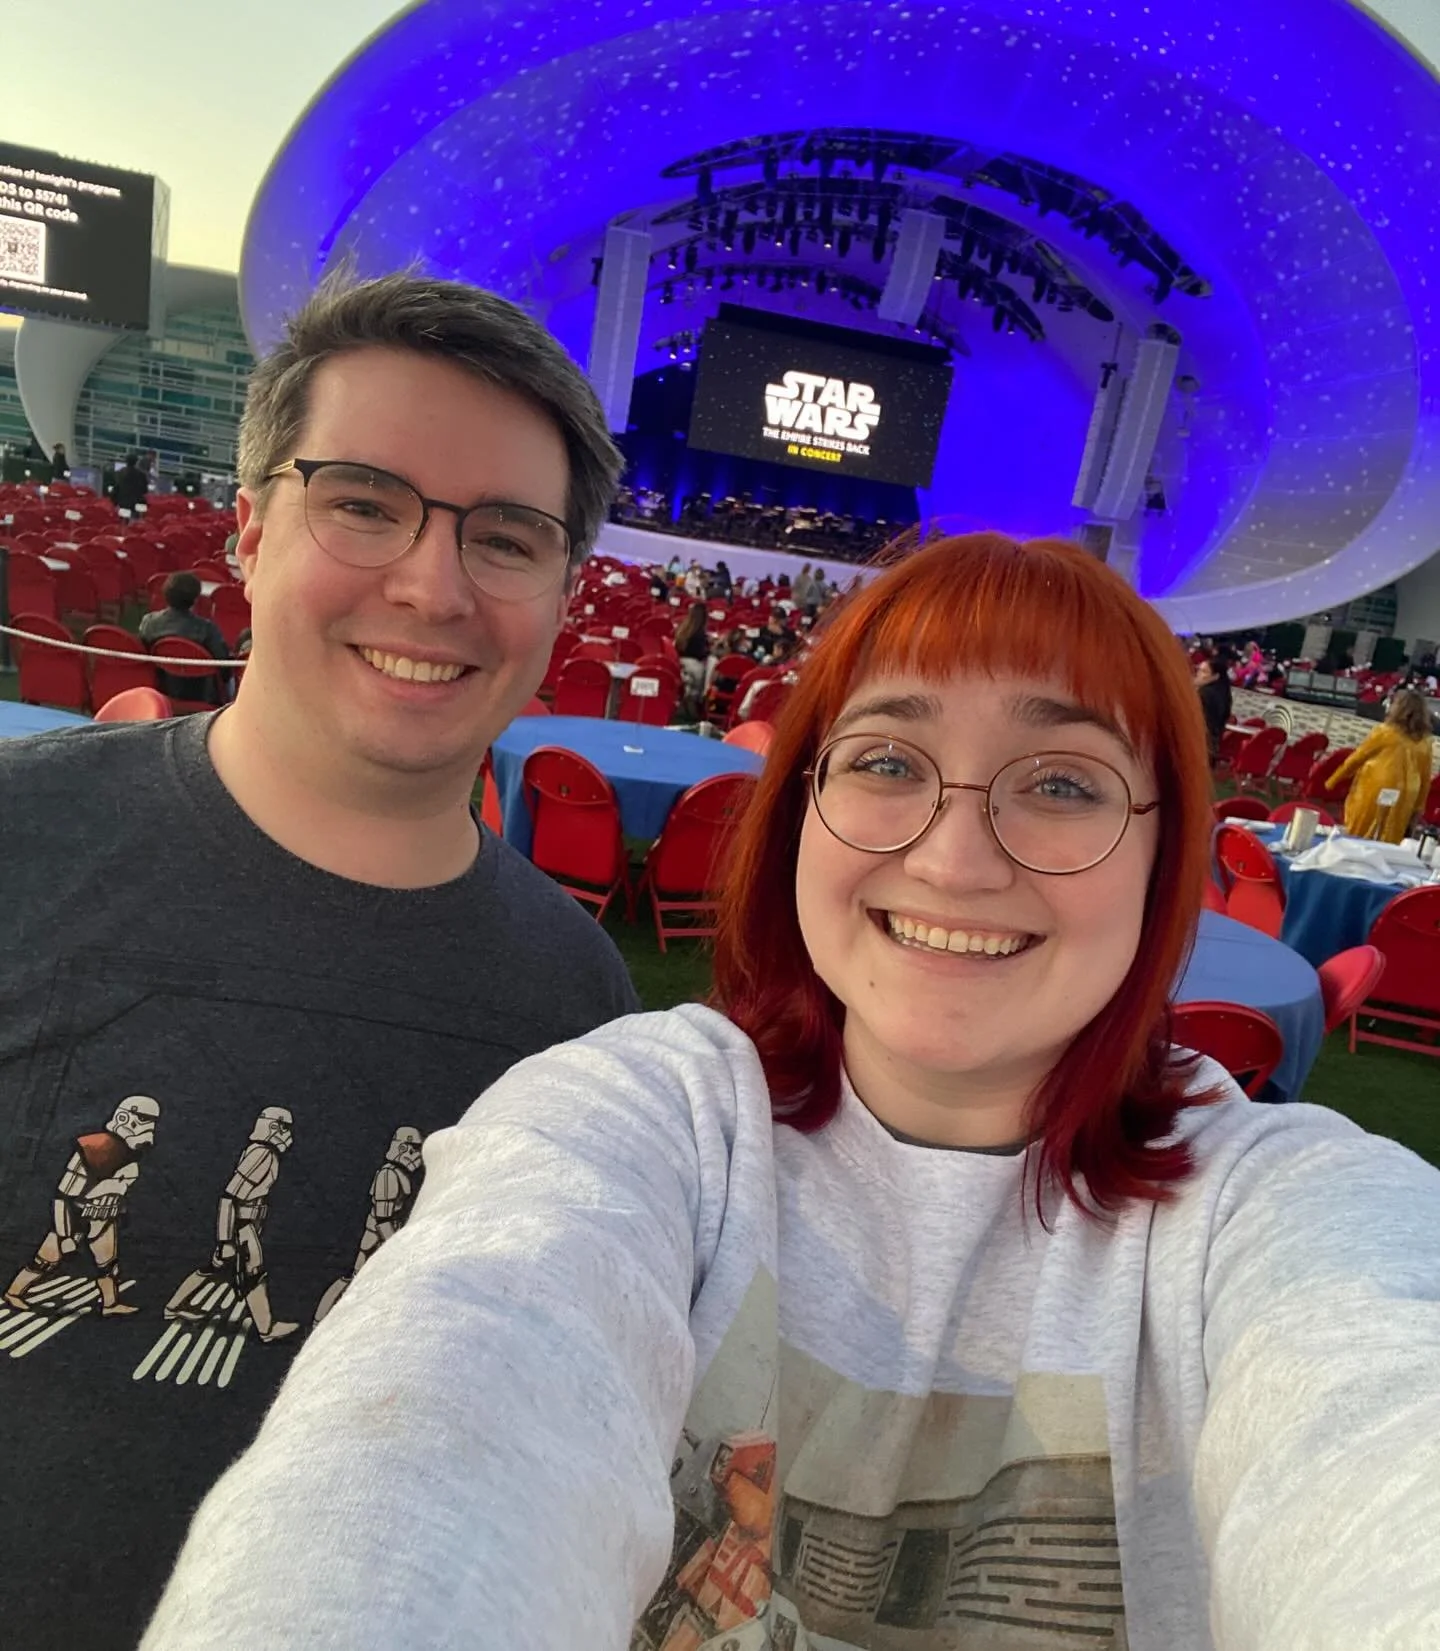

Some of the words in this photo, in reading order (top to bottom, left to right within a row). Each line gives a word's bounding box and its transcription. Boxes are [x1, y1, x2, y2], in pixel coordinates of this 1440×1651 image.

[24, 169, 35, 179] of
[18, 186, 34, 199] to
[35, 188, 69, 206] 55741
[23, 201, 45, 216] QR
[45, 207, 79, 223] code
[765, 370, 881, 417] STAR
[765, 396, 880, 441] WARS
[762, 427, 780, 439] THE
[781, 430, 812, 445] EMPIRE
[813, 436, 845, 451] STRIKES
[846, 442, 870, 455] BACK
[787, 444, 799, 455] IN
[800, 447, 842, 462] CONCERT
